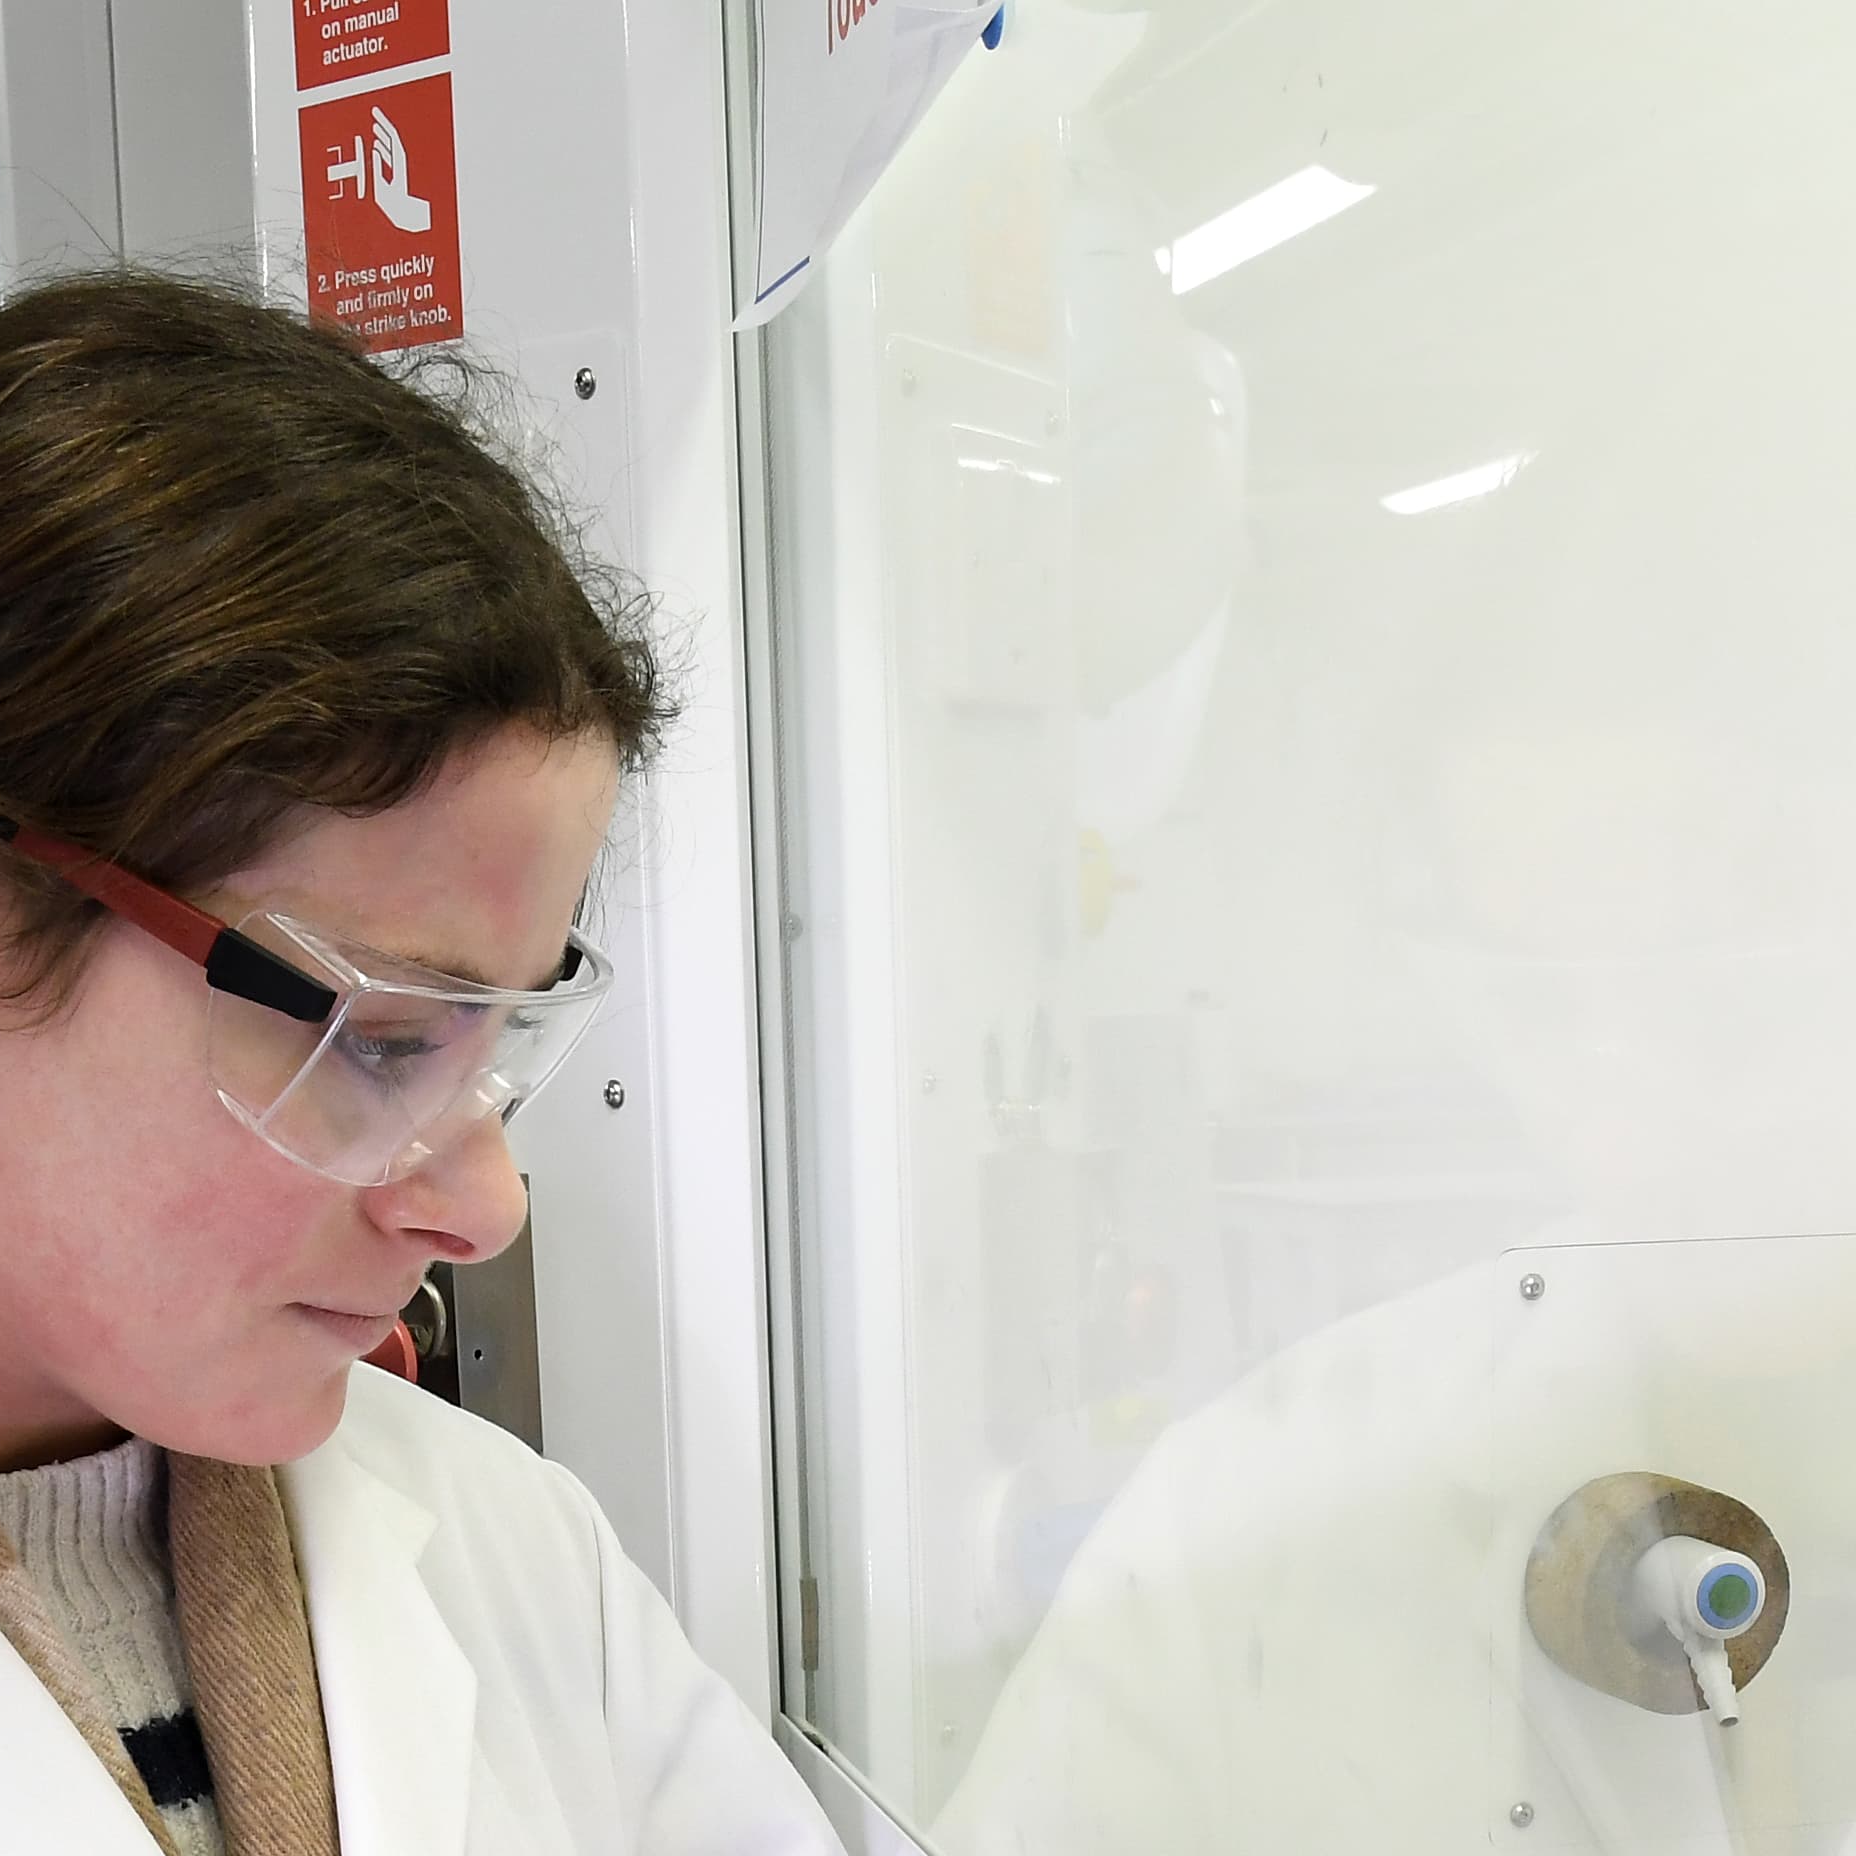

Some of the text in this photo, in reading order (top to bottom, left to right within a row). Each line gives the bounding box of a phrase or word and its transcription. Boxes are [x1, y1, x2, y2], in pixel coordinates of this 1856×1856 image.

[321, 3, 400, 39] on manual
[322, 36, 389, 66] actuator.
[317, 253, 435, 294] 2. Press quickly
[336, 283, 434, 316] and firmly on
[364, 314, 407, 336] strike
[410, 303, 453, 329] knob.
